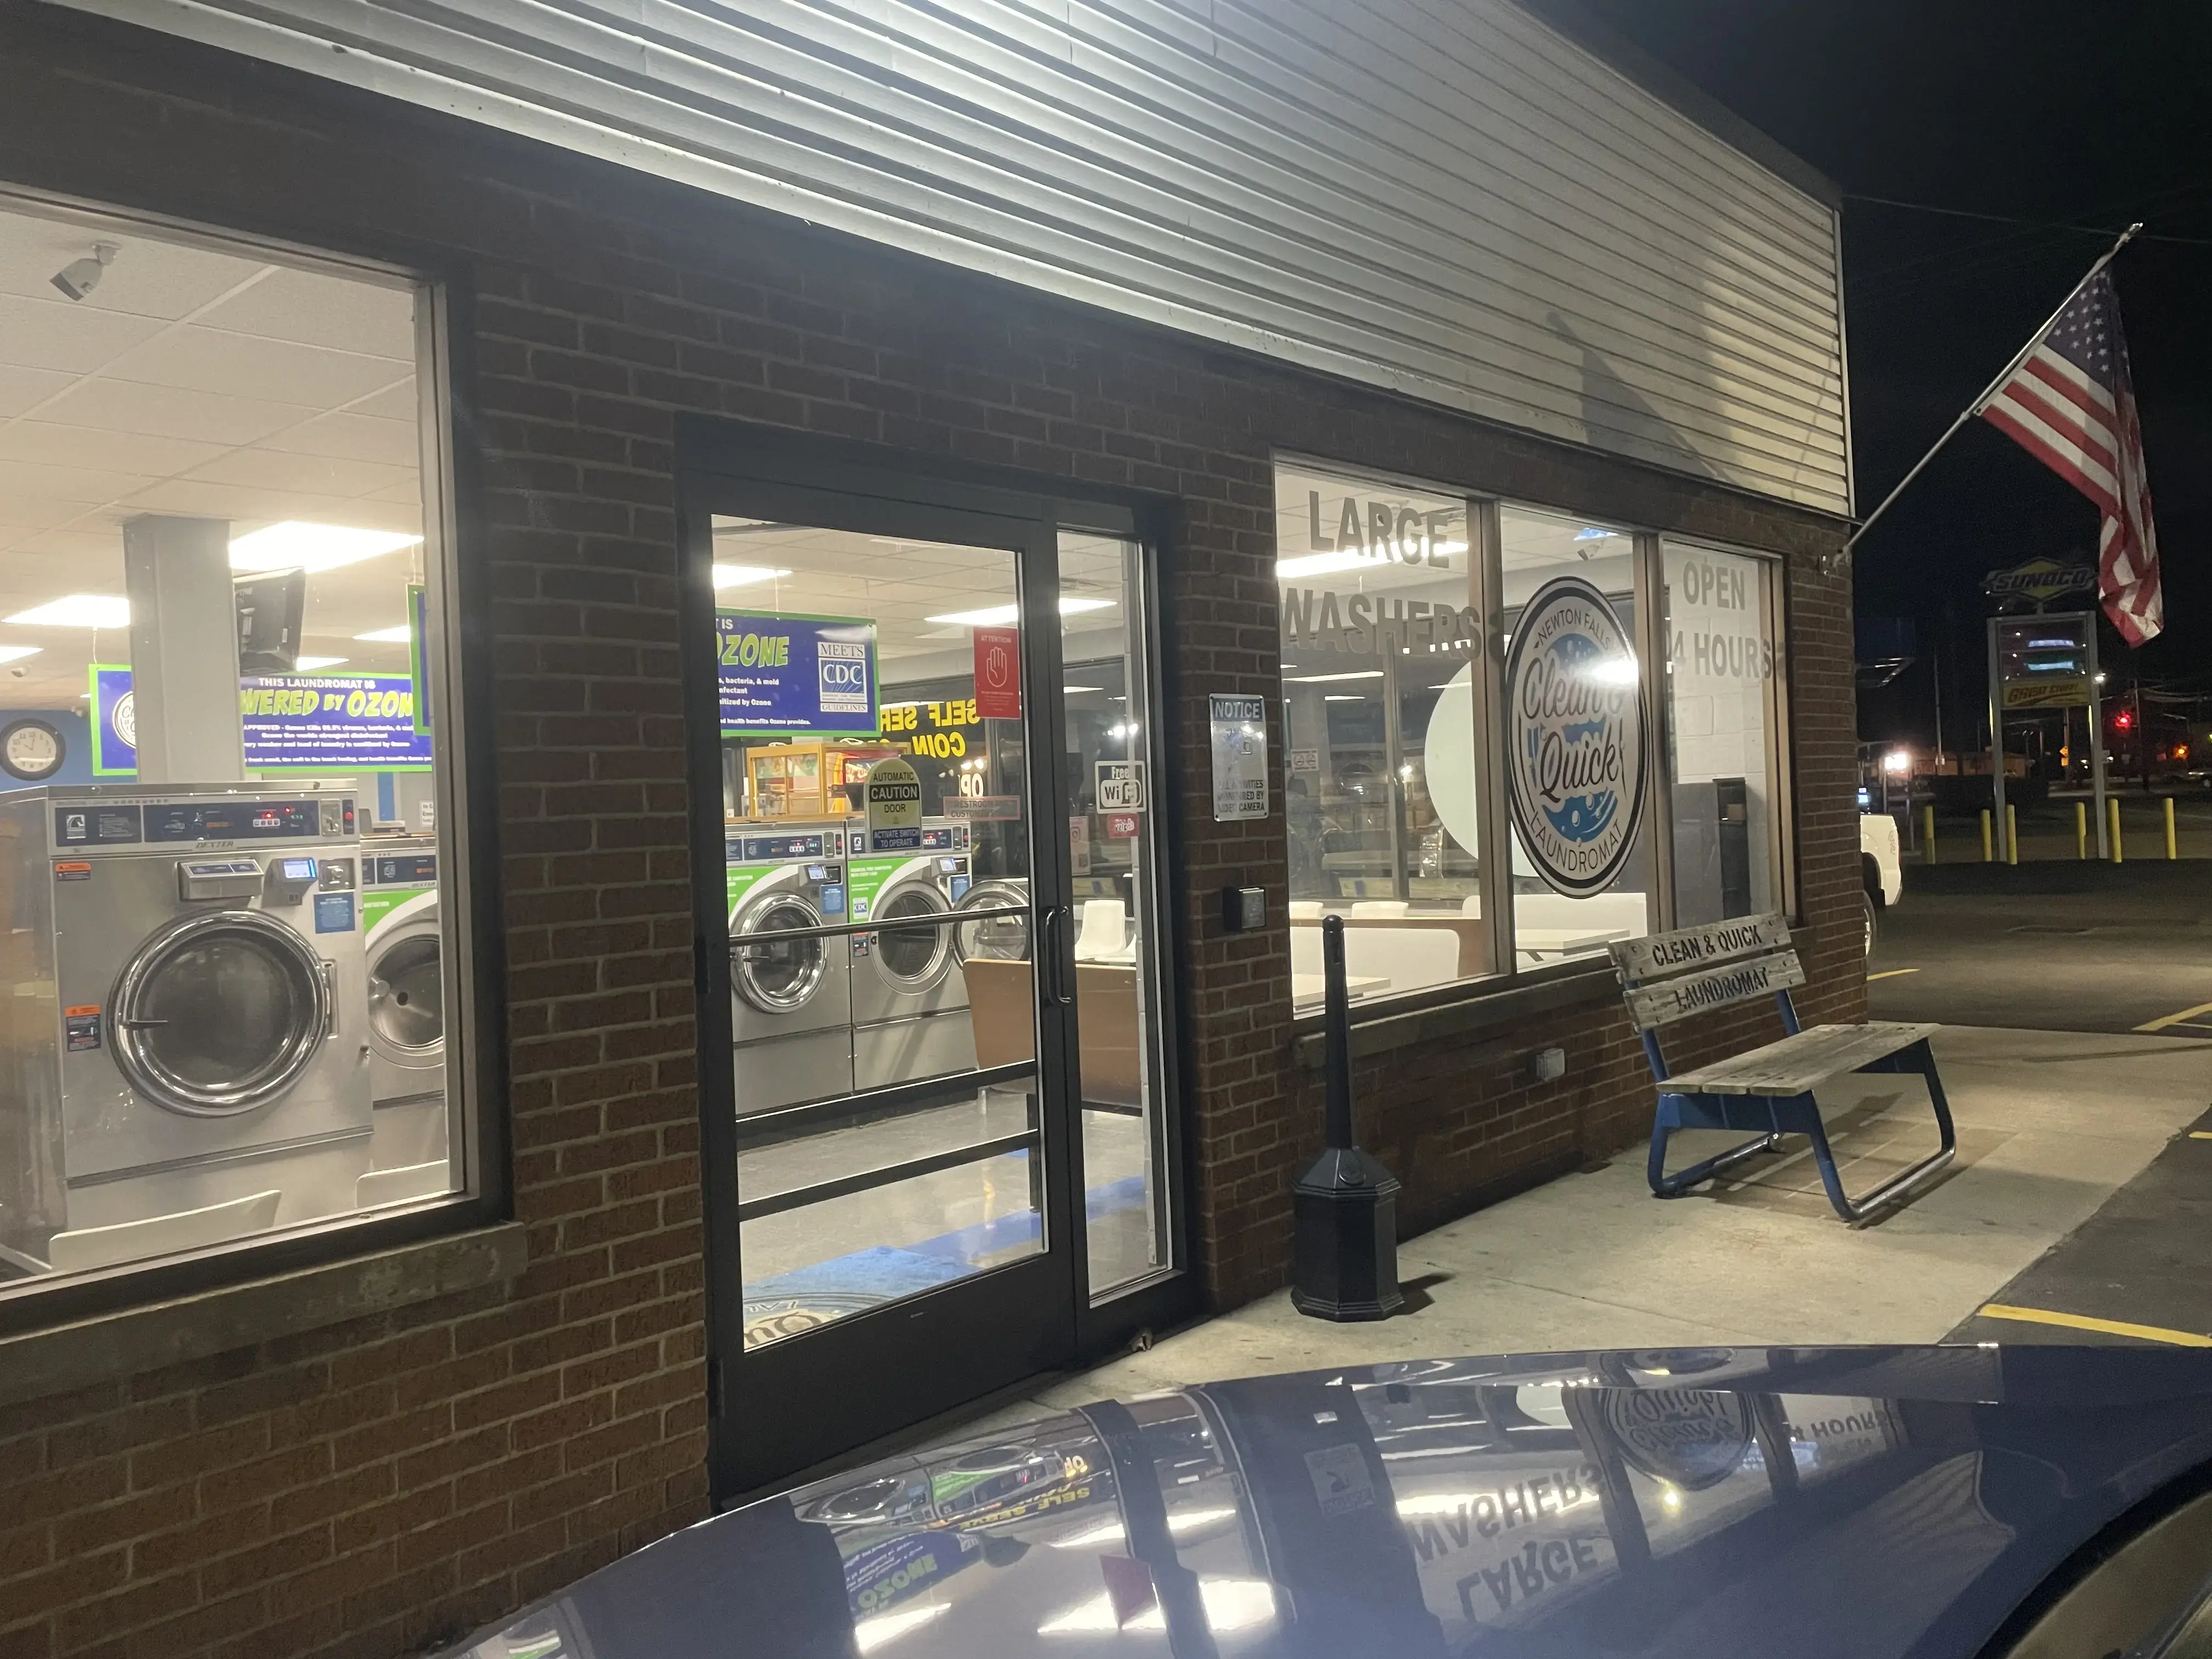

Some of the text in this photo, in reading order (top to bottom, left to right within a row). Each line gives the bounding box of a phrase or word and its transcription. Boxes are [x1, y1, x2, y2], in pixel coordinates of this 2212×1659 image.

[1309, 490, 1449, 568] LARGE
[1683, 560, 1745, 611] OPEN
[1993, 567, 2091, 590] SUNOCO
[721, 619, 733, 629] IS
[1279, 588, 1482, 661] WASHERS
[1537, 608, 1611, 650] NEWTON FALLS
[981, 635, 1012, 643] ATTENTION
[821, 644, 864, 657] MEETS
[1694, 633, 1772, 679] HOURS
[823, 664, 862, 684] CDC
[259, 678, 376, 689] THIS LAUNDROMAT IS
[1522, 657, 1602, 720] Clean
[324, 694, 345, 710] BY
[1215, 702, 1260, 718] NOTICE
[1539, 722, 1620, 803] Quick
[873, 772, 914, 782] AUTOMATIC
[1111, 766, 1130, 780] Free
[871, 786, 918, 799] CAUTION
[1256, 791, 1264, 799] BY
[884, 804, 906, 813] DOOR
[1239, 802, 1265, 812] CAMERA
[874, 828, 919, 839] ACTIVATE SWITCH
[1530, 811, 1623, 872] LAUNDROMAT
[881, 838, 913, 848] TO OPERATE
[1652, 924, 1763, 966] CLEAN & QUICK
[1674, 967, 1770, 1010] LAUNDROMAT
